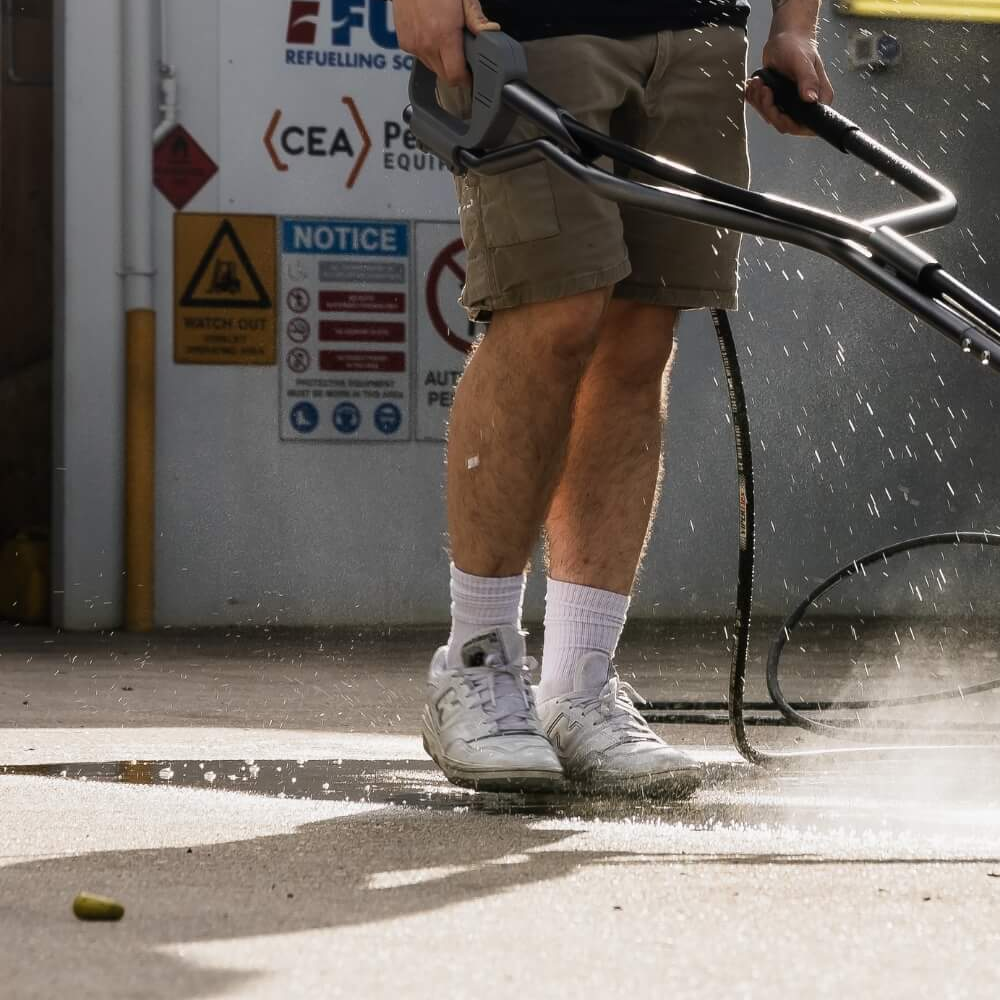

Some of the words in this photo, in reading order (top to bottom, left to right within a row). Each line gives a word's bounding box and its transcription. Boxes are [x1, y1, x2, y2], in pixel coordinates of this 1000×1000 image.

[286, 49, 386, 70] REFUELLING
[280, 126, 354, 157] CEA
[293, 225, 397, 251] NOTICE
[184, 317, 231, 330] WATCH
[238, 318, 268, 331] OUT
